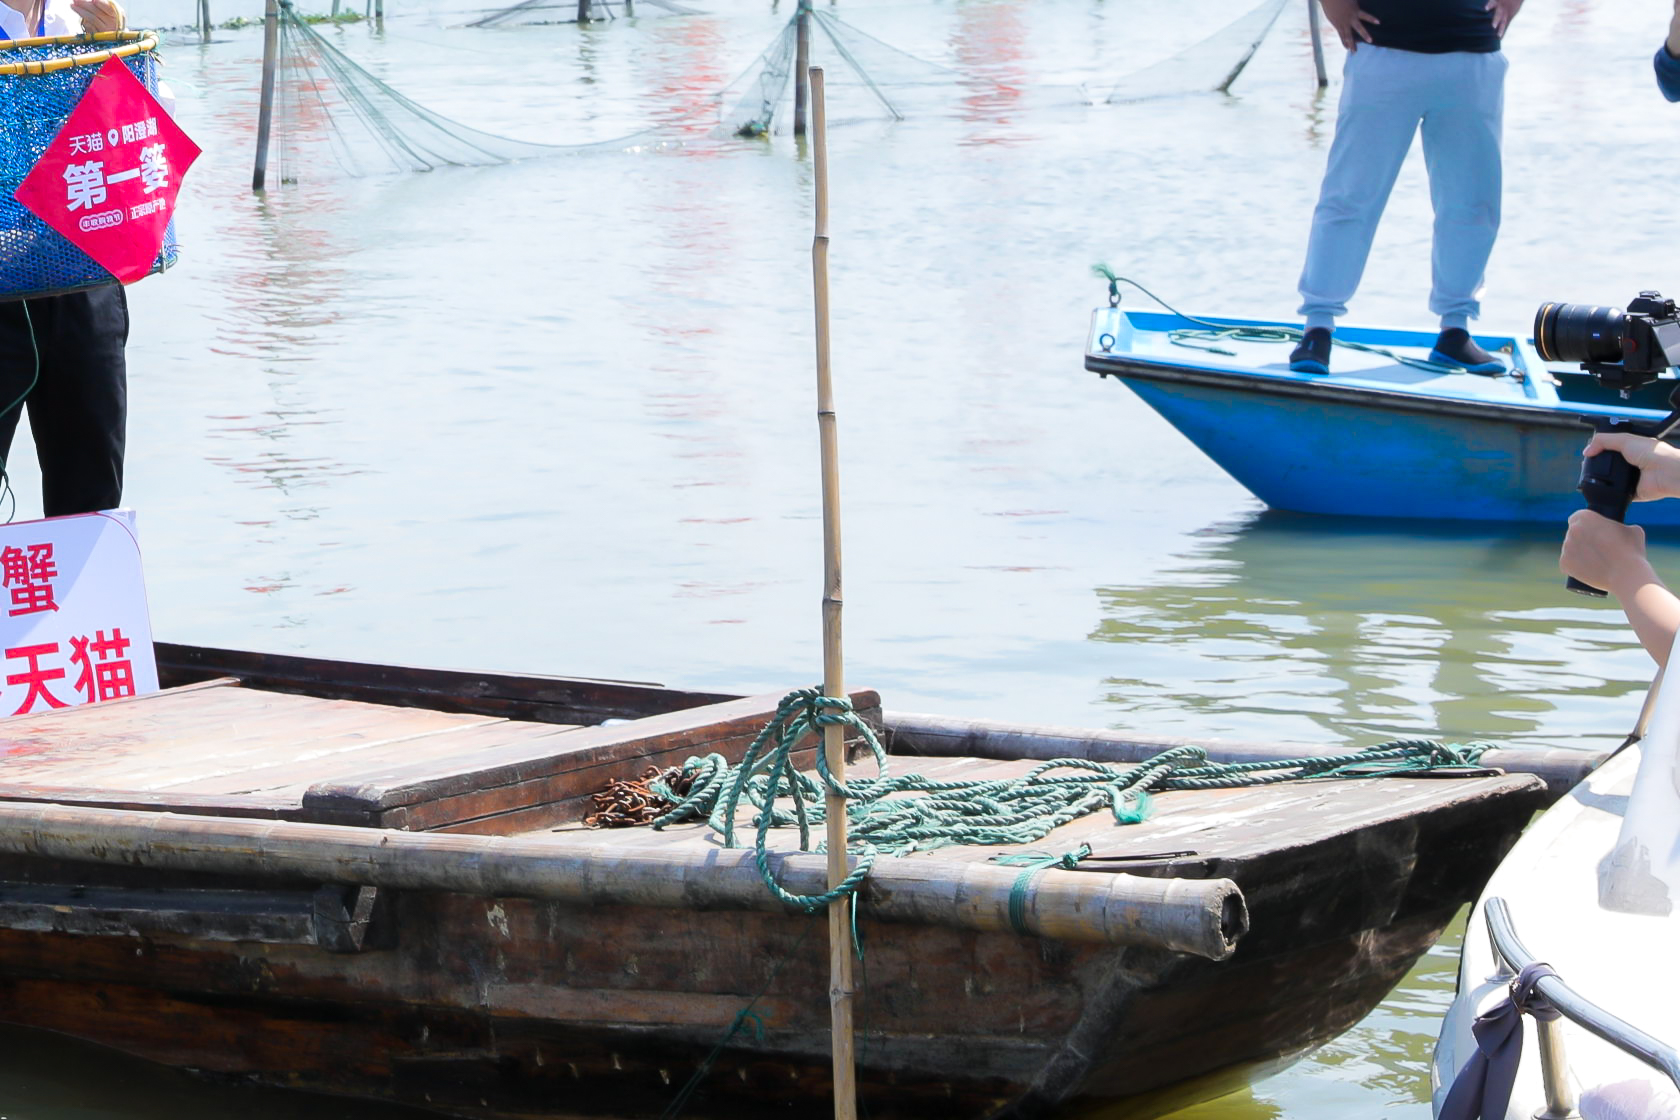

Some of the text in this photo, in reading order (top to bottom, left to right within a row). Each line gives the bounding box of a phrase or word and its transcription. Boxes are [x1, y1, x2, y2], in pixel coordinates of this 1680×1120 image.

[69, 117, 158, 157] 天猫 阳澄湖
[62, 143, 169, 212] 第一篓
